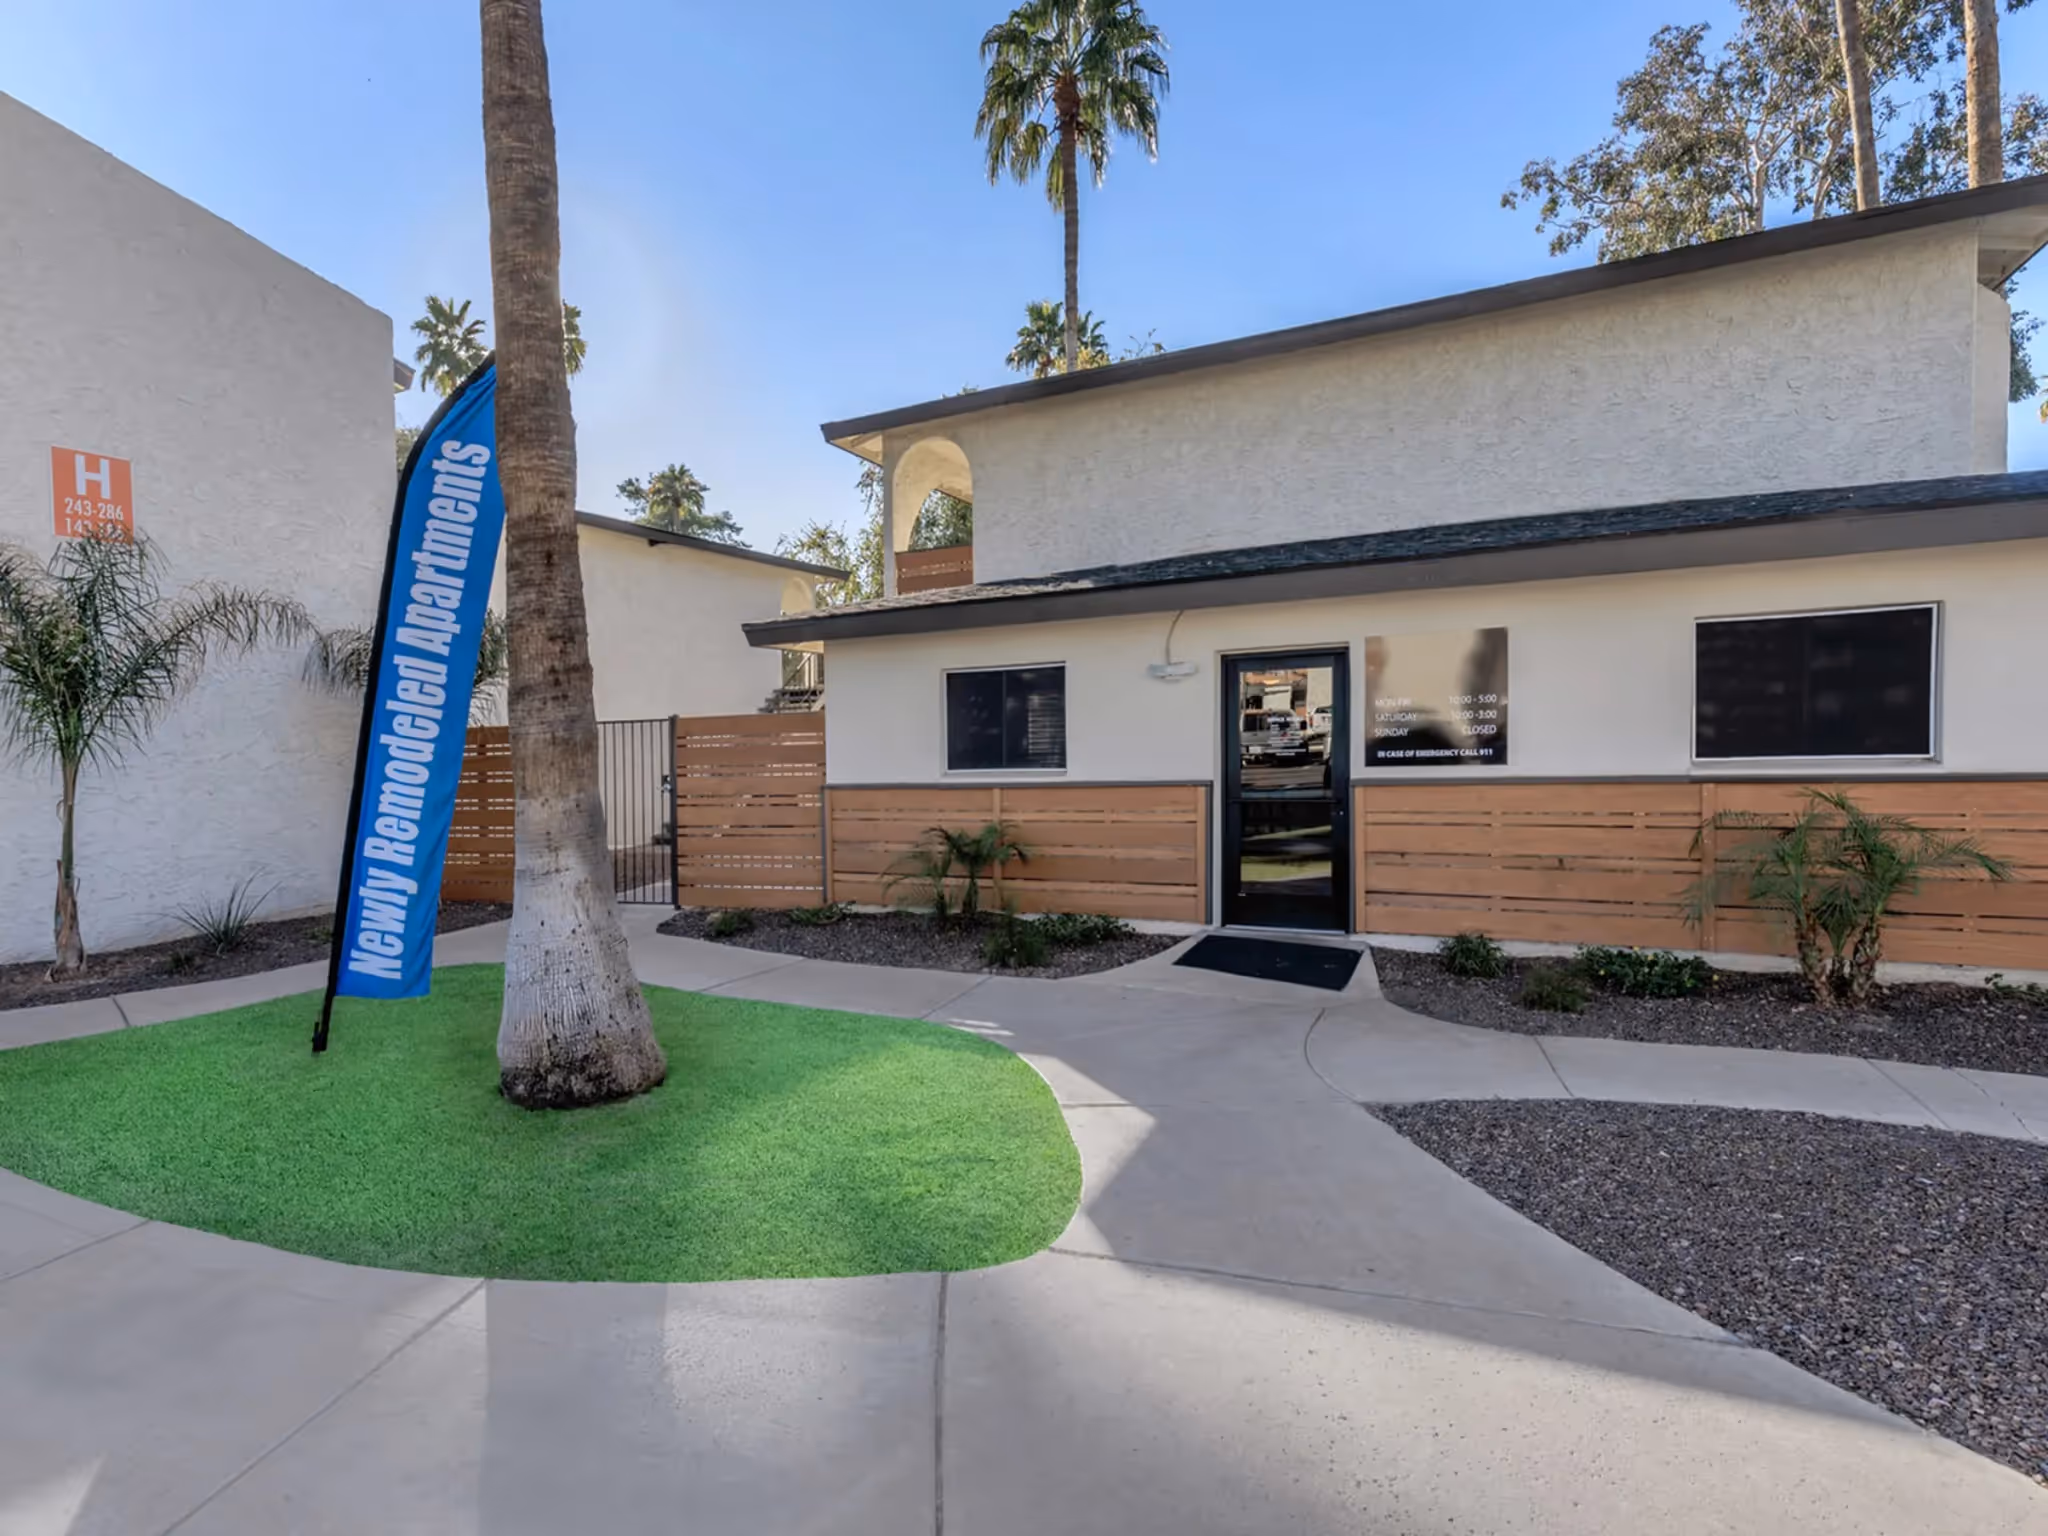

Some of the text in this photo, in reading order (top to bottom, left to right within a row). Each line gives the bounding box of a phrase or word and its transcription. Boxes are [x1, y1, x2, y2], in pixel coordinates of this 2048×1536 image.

[74, 453, 111, 500] H
[64, 496, 124, 521] 243-286
[348, 439, 492, 980] Newly Remodeled Apartments
[1375, 711, 1416, 721] SATURDAY
[1374, 724, 1497, 737] SUNDAY CLOSED
[1377, 747, 1493, 758] IN CASE OF EMERGENCY CALL 911
